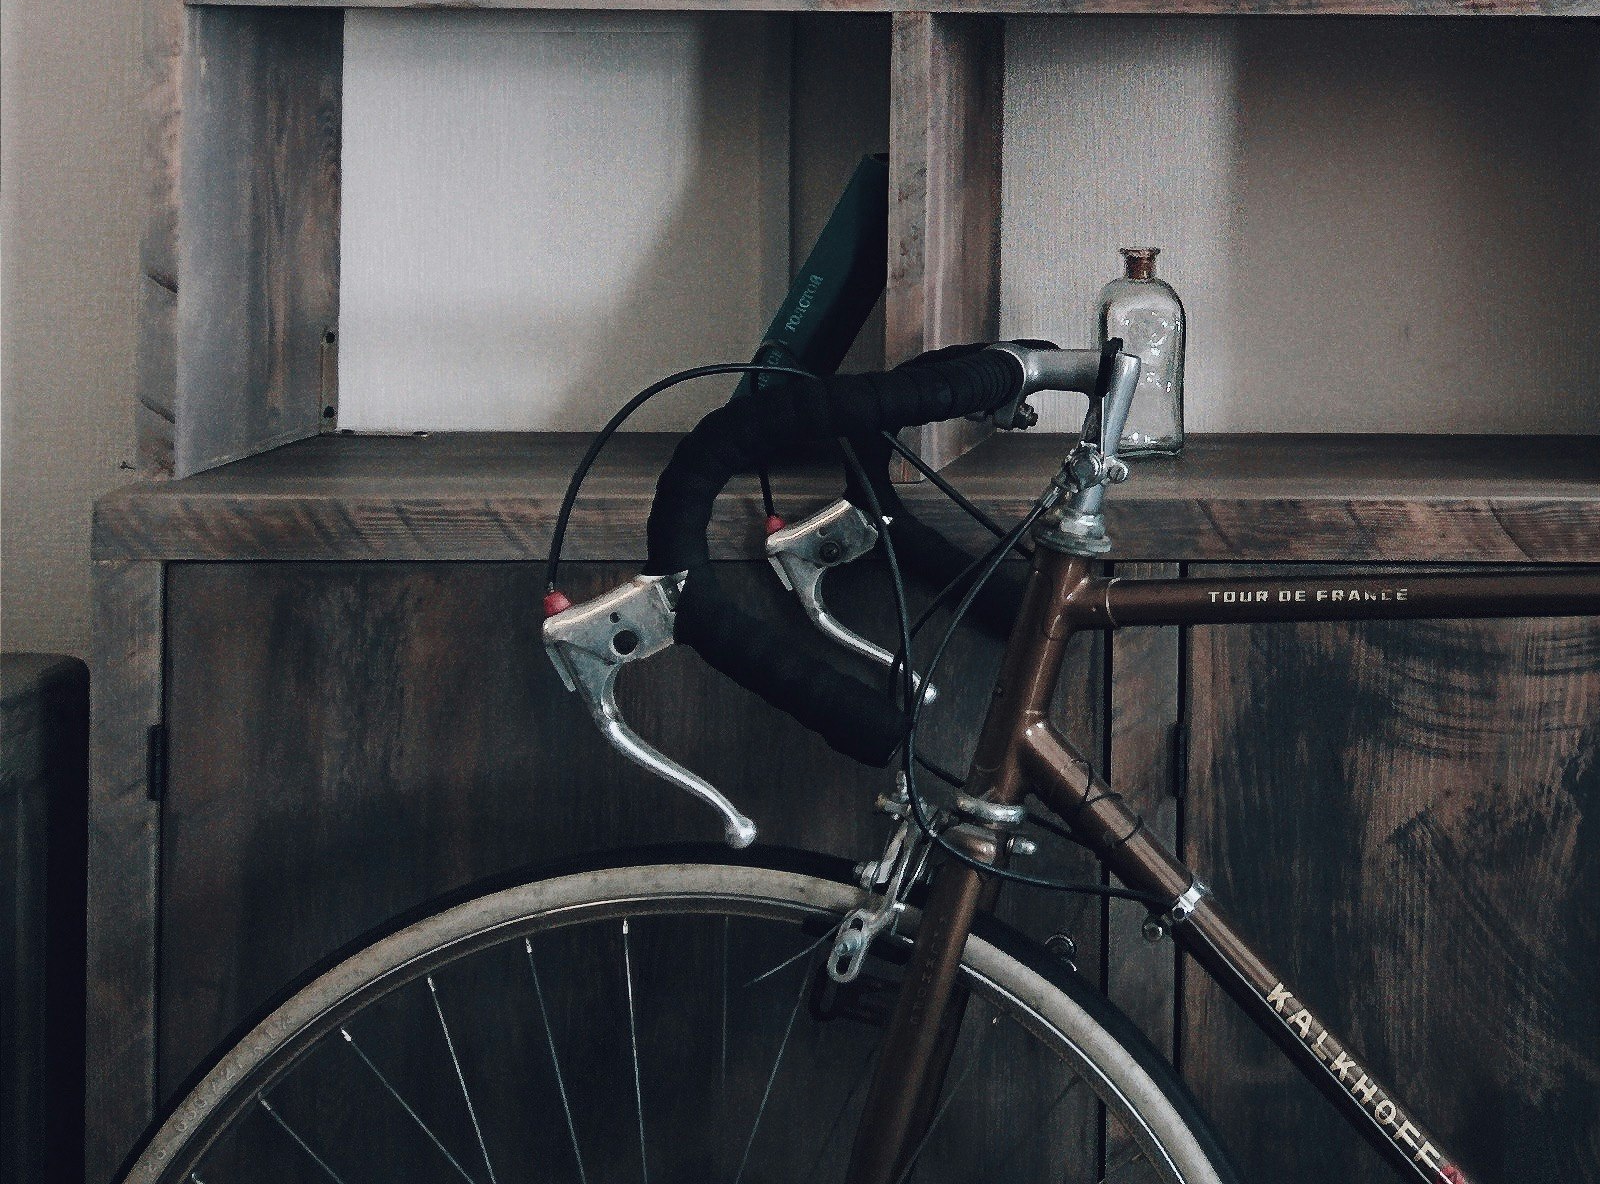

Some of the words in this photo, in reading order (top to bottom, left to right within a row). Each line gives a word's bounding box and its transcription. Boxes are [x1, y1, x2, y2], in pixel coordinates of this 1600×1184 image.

[1208, 590, 1269, 603] TOUR
[1278, 590, 1306, 603] DE
[1316, 588, 1409, 603] FRANCE
[1267, 981, 1442, 1169] KALKHOFF
